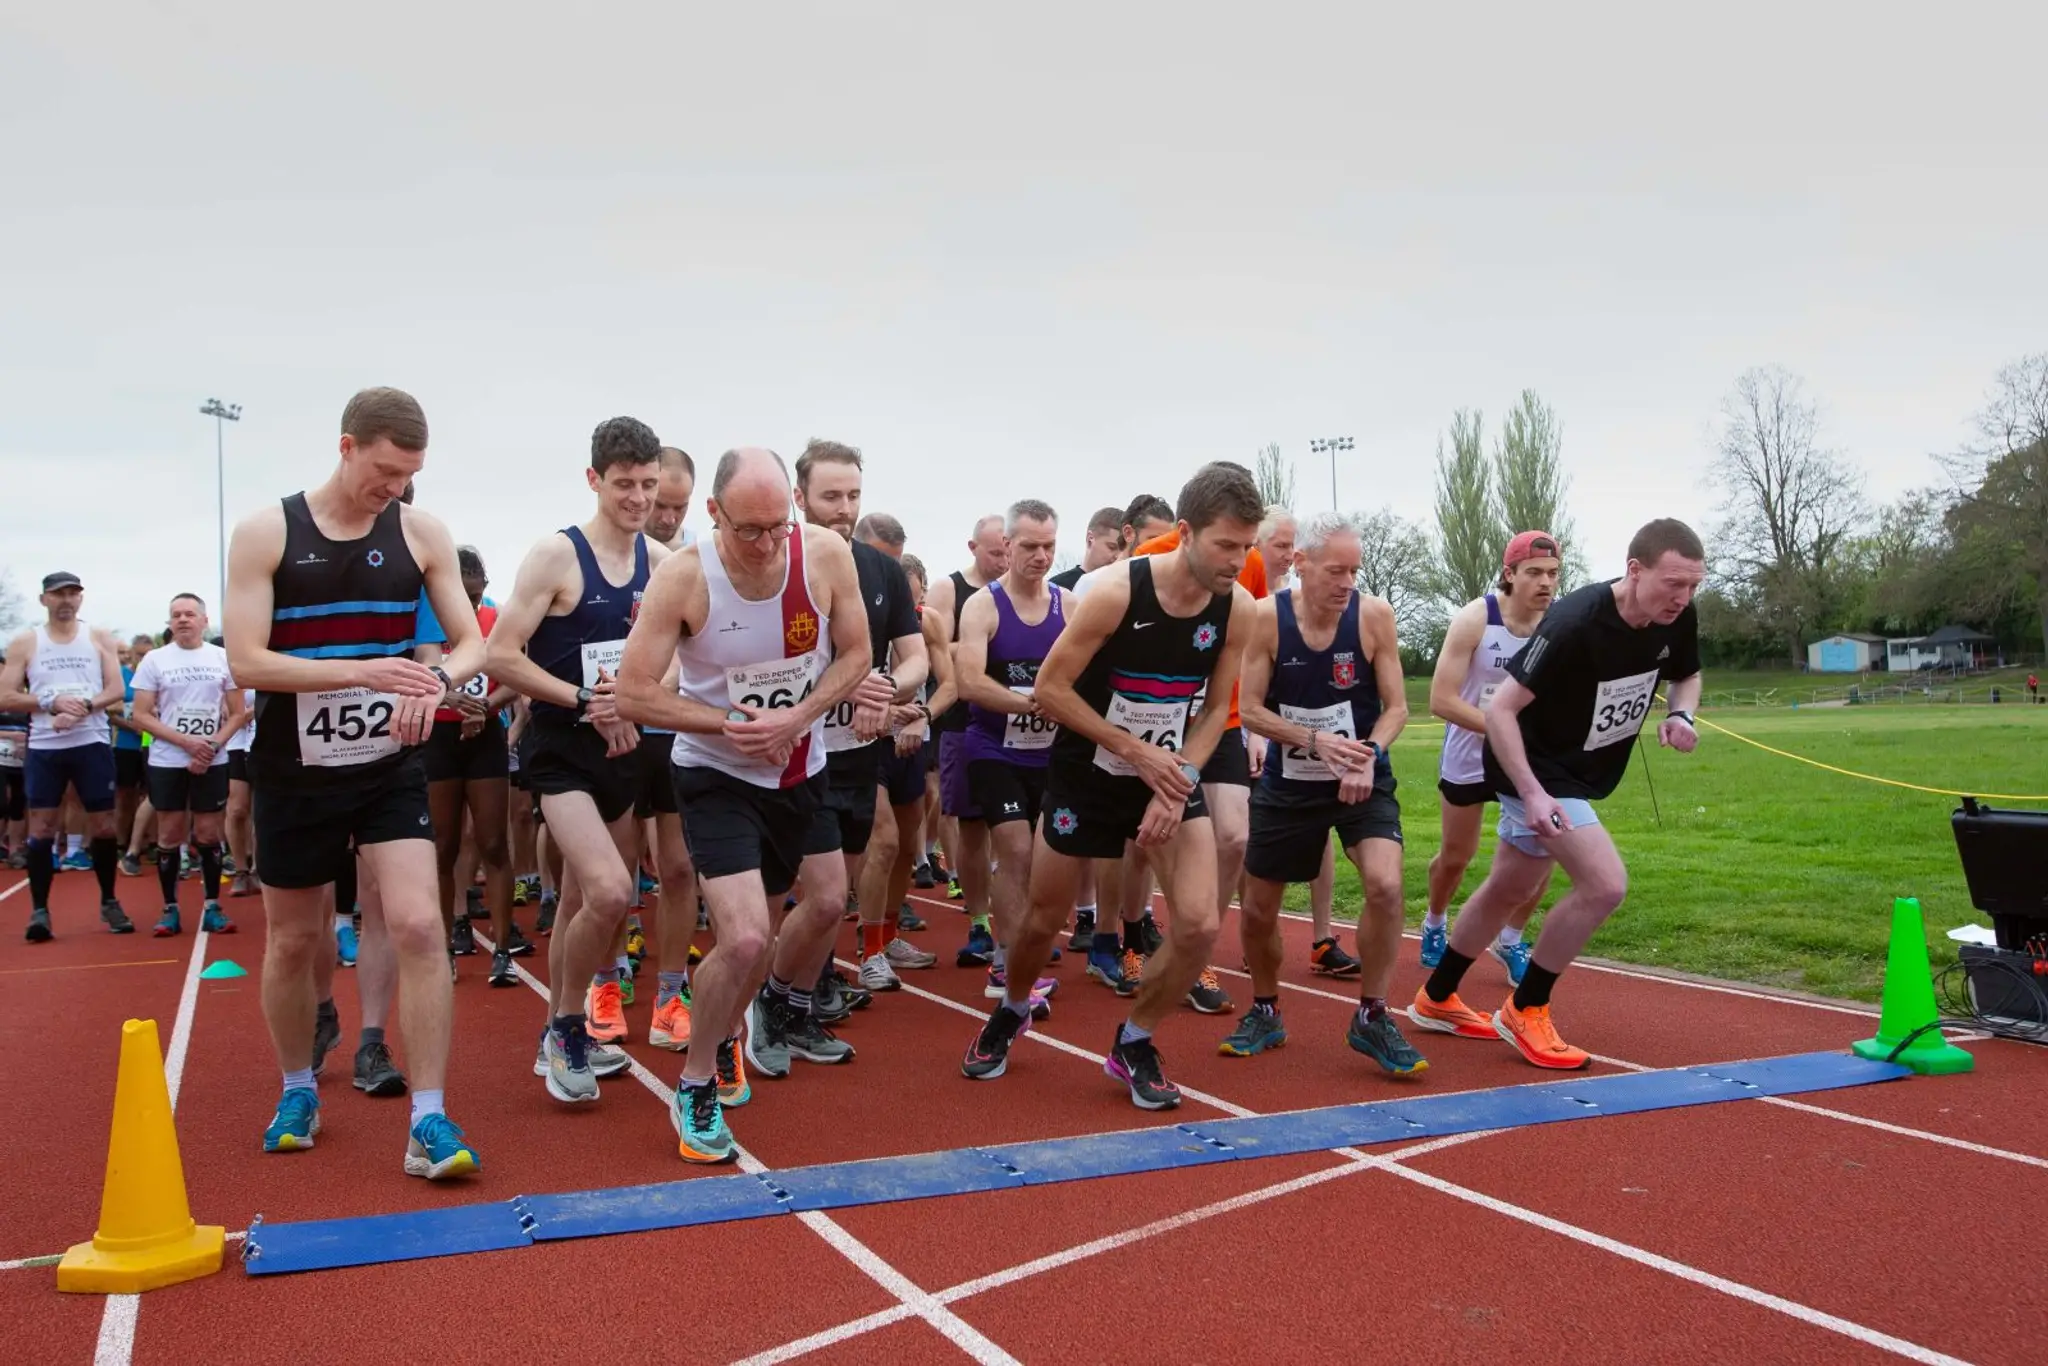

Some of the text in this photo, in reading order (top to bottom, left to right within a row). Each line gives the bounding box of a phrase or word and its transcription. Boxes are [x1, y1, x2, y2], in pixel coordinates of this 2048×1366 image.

[771, 666, 802, 678] PEPPER
[170, 674, 216, 683] RUNNERS
[749, 678, 792, 688] MEMORIAL
[317, 691, 361, 701] MEMORIAL
[1596, 693, 1647, 732] 336
[176, 718, 215, 735] 526
[306, 701, 394, 743] 452
[1122, 716, 1160, 726] MEMORIAL
